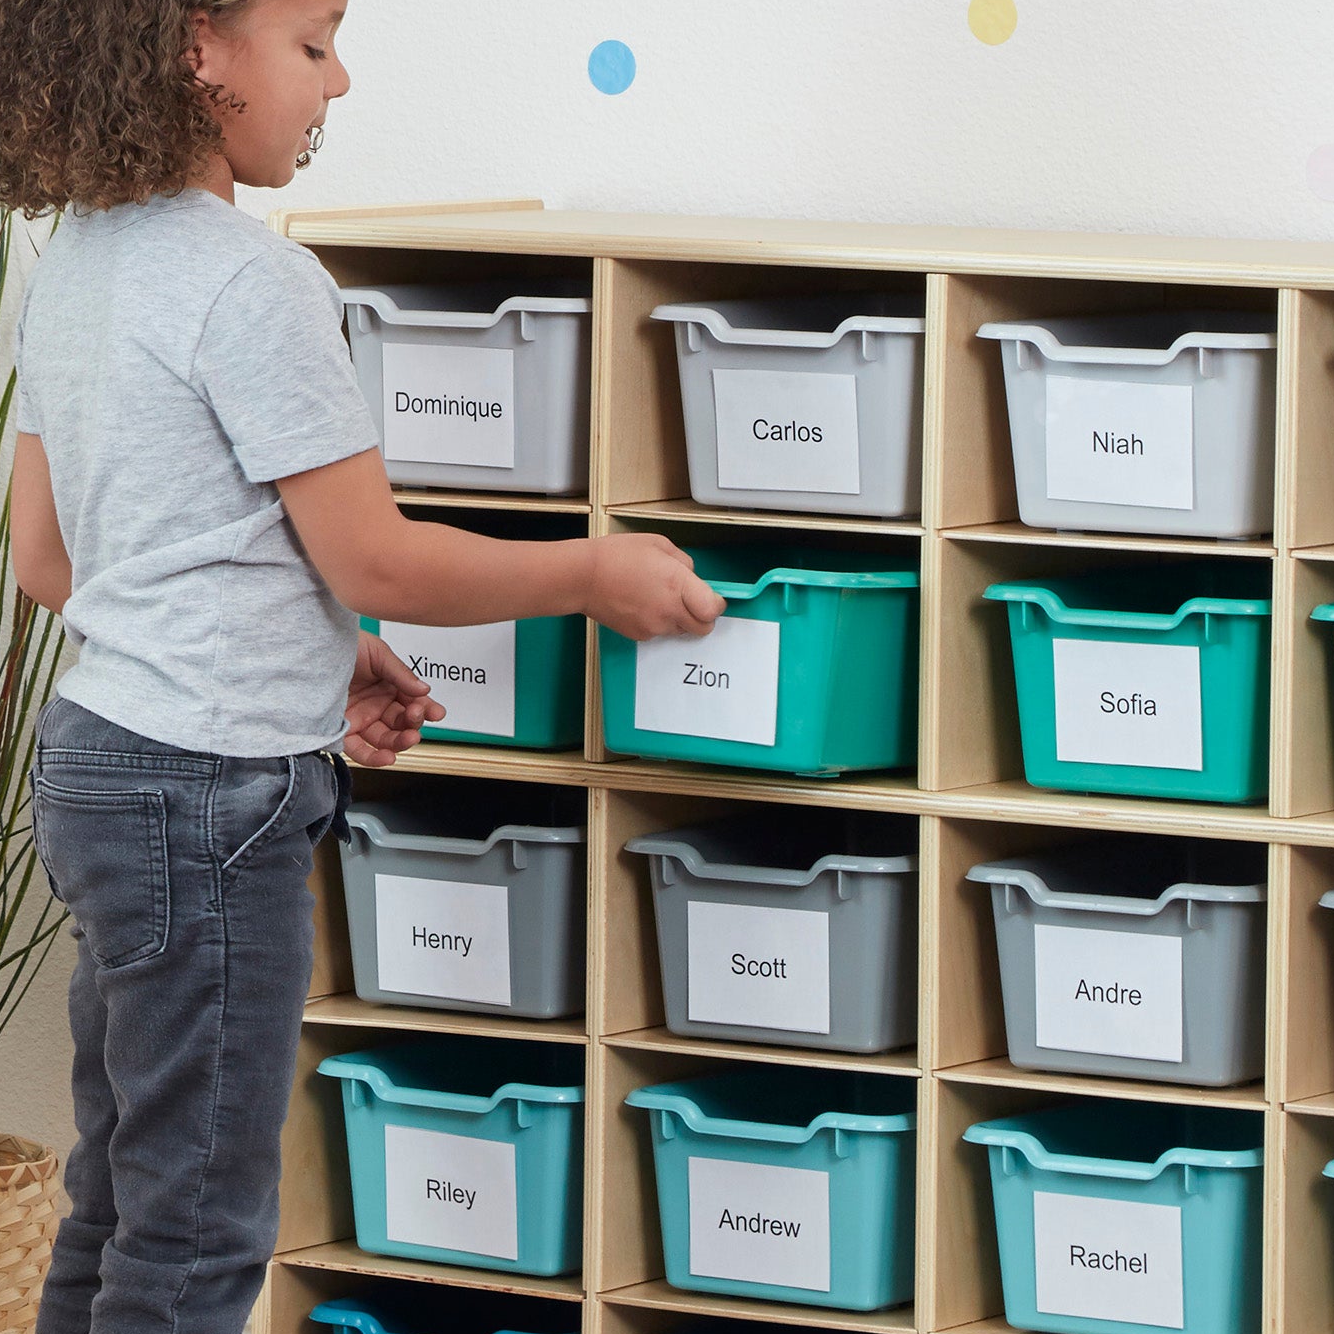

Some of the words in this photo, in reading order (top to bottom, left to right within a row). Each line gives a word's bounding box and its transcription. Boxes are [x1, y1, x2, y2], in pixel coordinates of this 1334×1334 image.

[395, 391, 503, 423] Dominique
[752, 418, 823, 443] Carlos
[1092, 430, 1144, 456] Niah
[408, 654, 487, 685] Ximena
[682, 662, 730, 689] Zion
[1100, 691, 1157, 717] Sofia
[412, 925, 473, 958] Henry
[731, 953, 787, 979] Scott
[1074, 978, 1142, 1006] Andre
[426, 1178, 477, 1211] Riley
[718, 1208, 801, 1238] Andrew
[1070, 1244, 1148, 1275] Rachel
